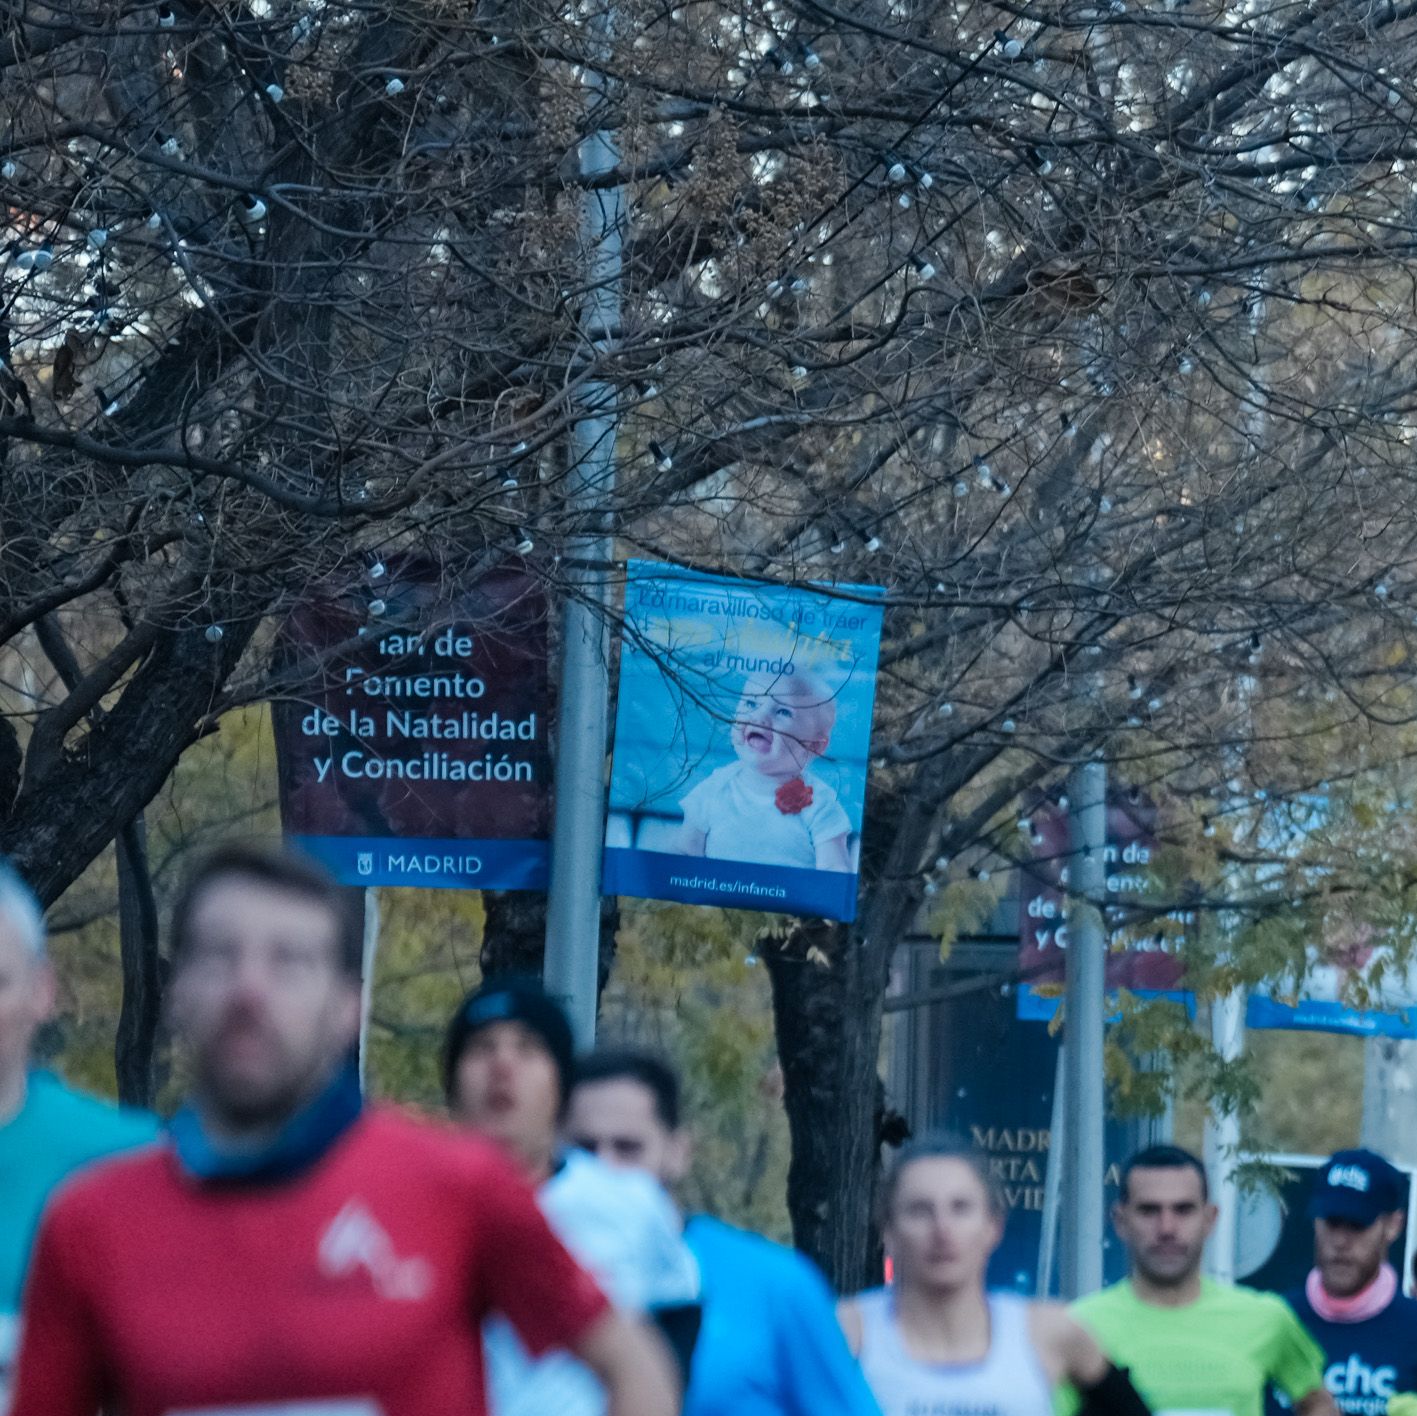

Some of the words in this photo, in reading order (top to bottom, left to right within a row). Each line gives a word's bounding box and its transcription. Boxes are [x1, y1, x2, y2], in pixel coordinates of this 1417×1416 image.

[667, 593, 785, 622] maravilloso
[791, 604, 816, 625] de
[823, 612, 868, 632] traer
[358, 627, 425, 656] lan
[434, 629, 474, 658] de
[702, 652, 720, 668] al
[726, 657, 796, 677] mundo
[301, 709, 340, 736] de
[350, 710, 376, 737] la
[386, 711, 538, 741] Natalidad
[313, 755, 332, 783] y
[341, 751, 533, 782] Conciliación
[388, 854, 483, 875] MADRID
[1122, 840, 1150, 864] de
[669, 875, 787, 899] madrid.es/infancia
[1028, 896, 1056, 919] de
[1035, 929, 1050, 951] y
[970, 1123, 1051, 1151] MADR
[1323, 1352, 1398, 1397] chc
